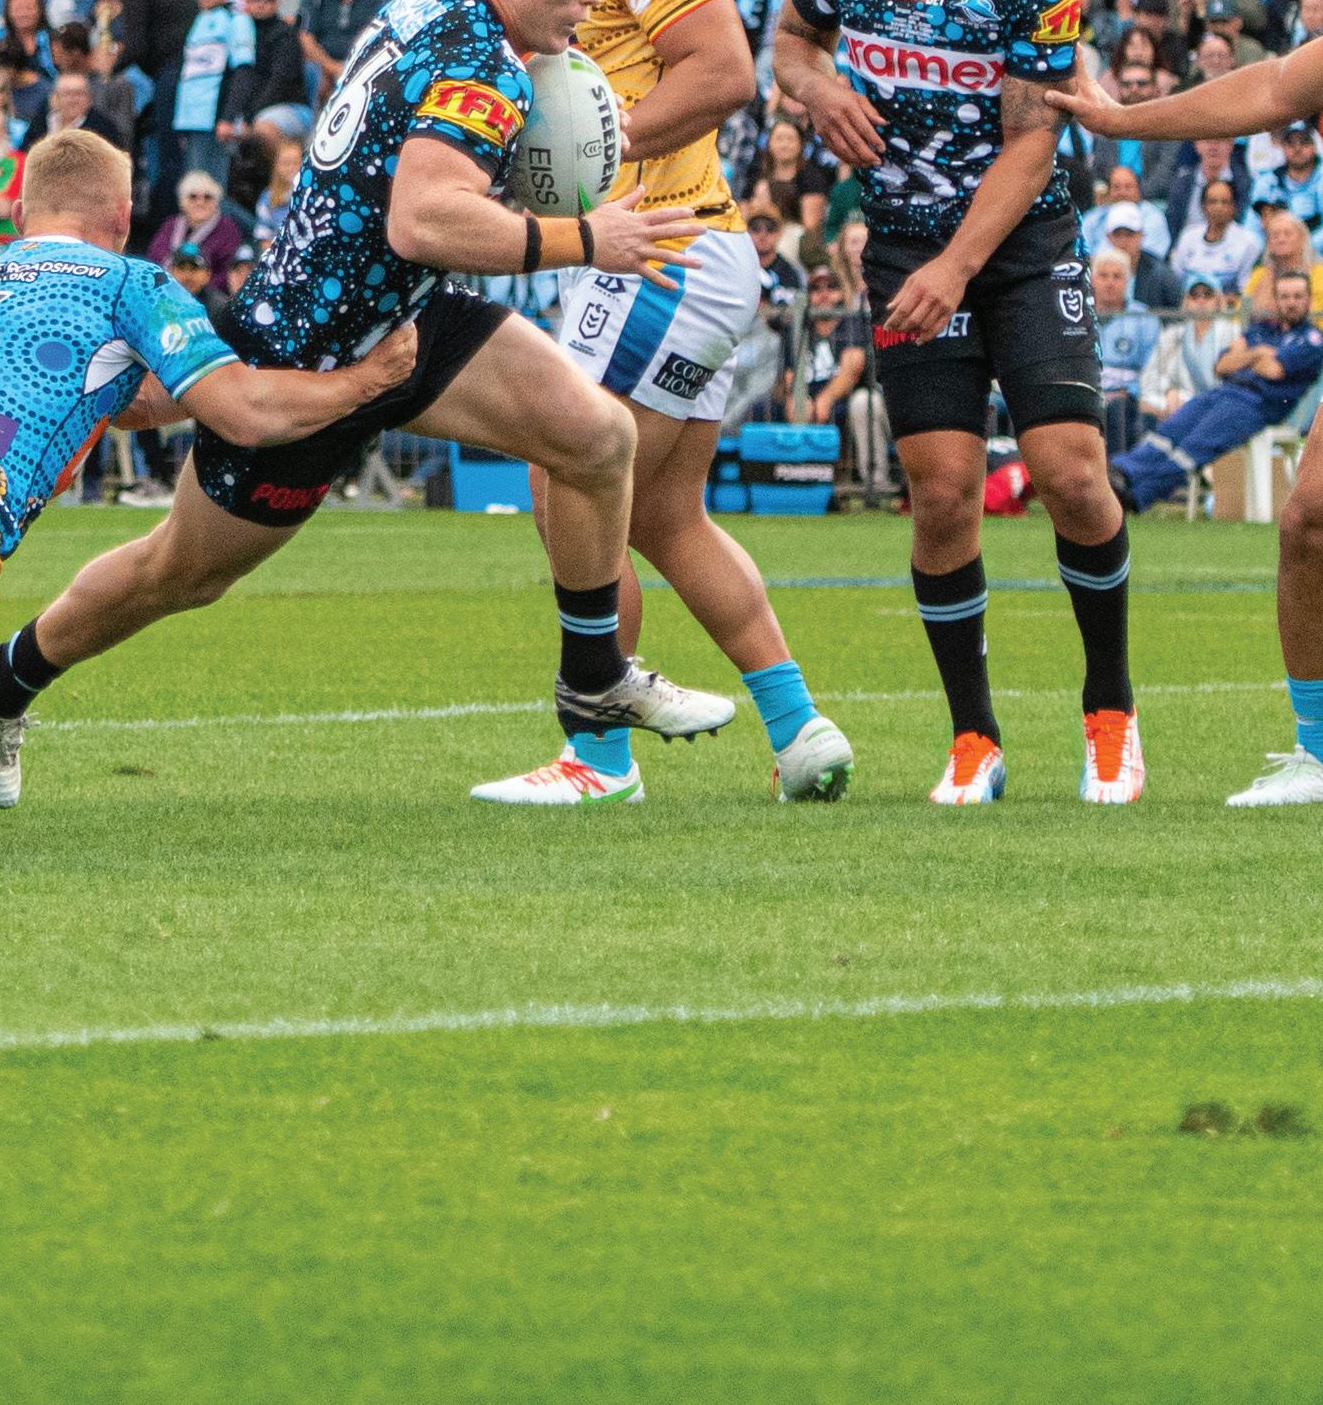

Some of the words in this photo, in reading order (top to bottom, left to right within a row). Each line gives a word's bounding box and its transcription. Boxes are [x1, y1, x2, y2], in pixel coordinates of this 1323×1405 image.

[846, 35, 1003, 91] ramex
[433, 83, 517, 143] TFH
[590, 84, 620, 196] STEEDEN
[528, 147, 561, 206] EISS
